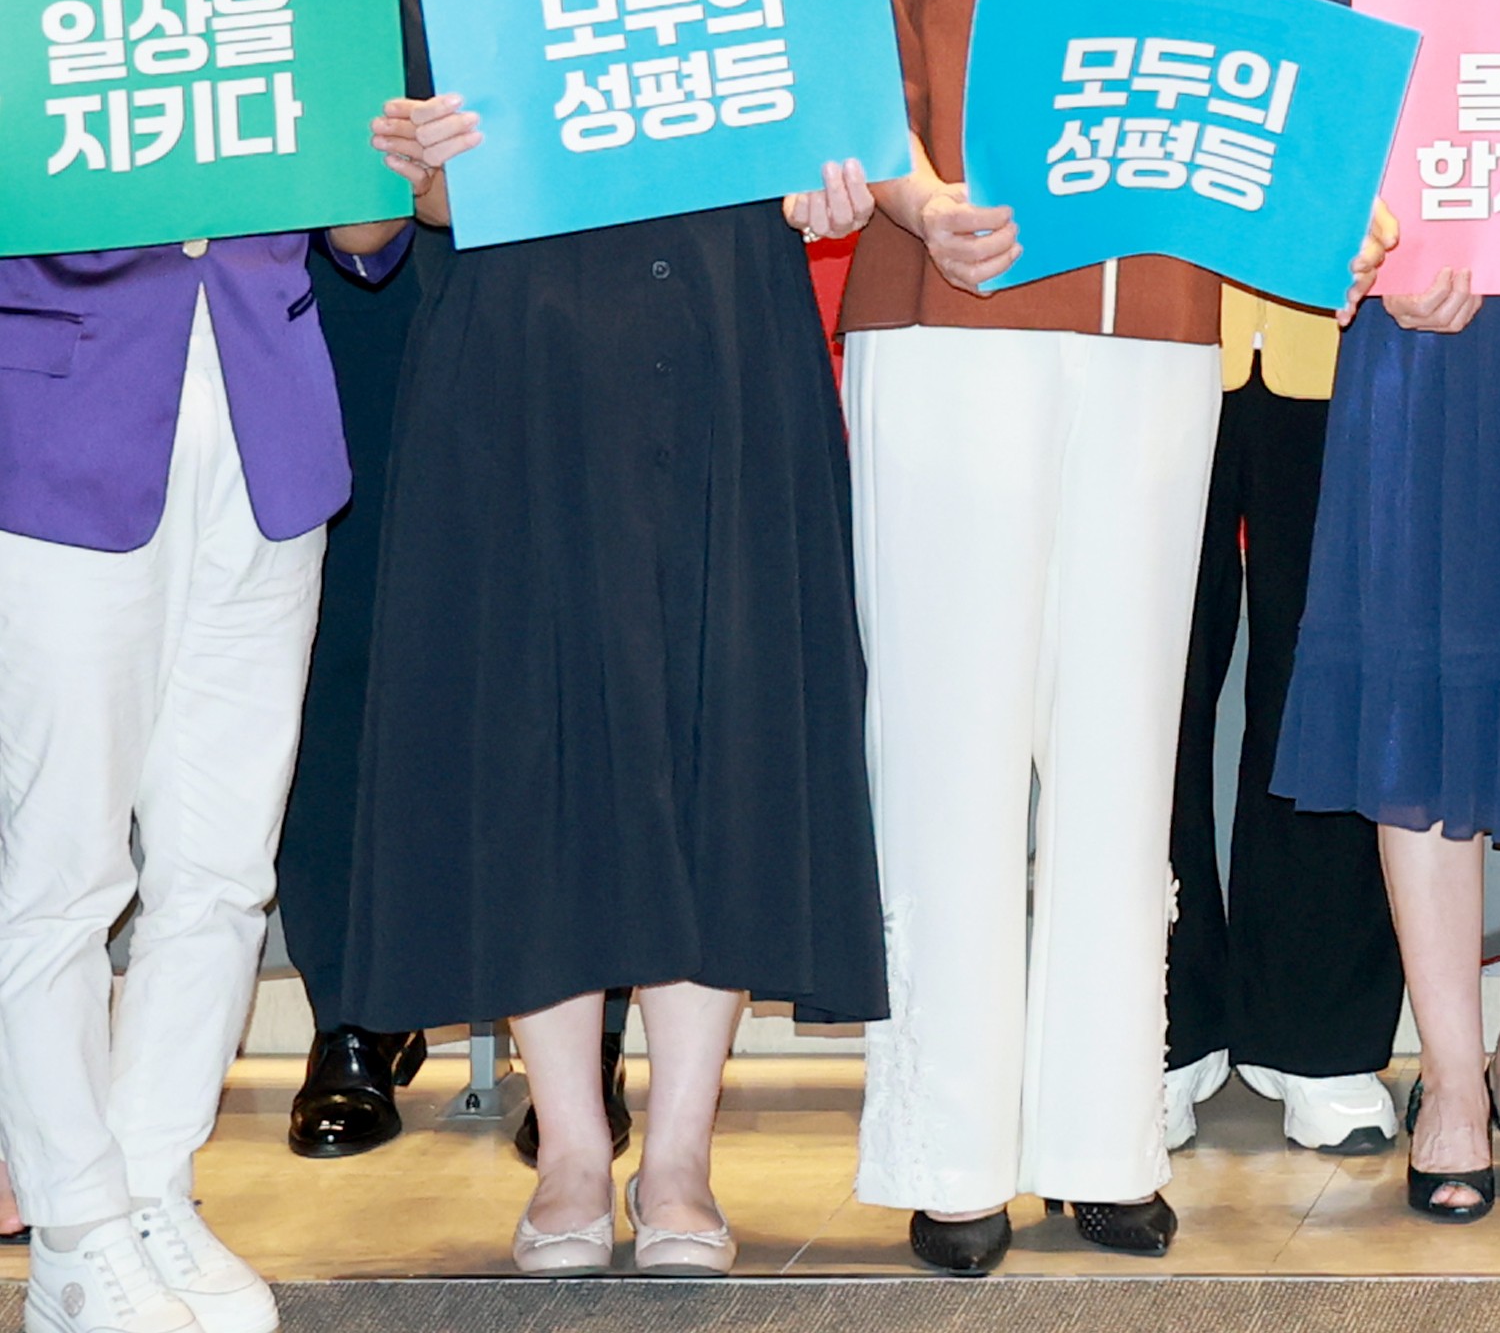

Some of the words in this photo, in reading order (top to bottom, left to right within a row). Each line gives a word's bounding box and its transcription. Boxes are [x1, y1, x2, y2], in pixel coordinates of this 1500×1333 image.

[46, 72, 302, 173] 지키다
[546, 39, 794, 152] 성평등
[1055, 38, 1298, 133] 모두의
[1048, 120, 1283, 210] 성평등
